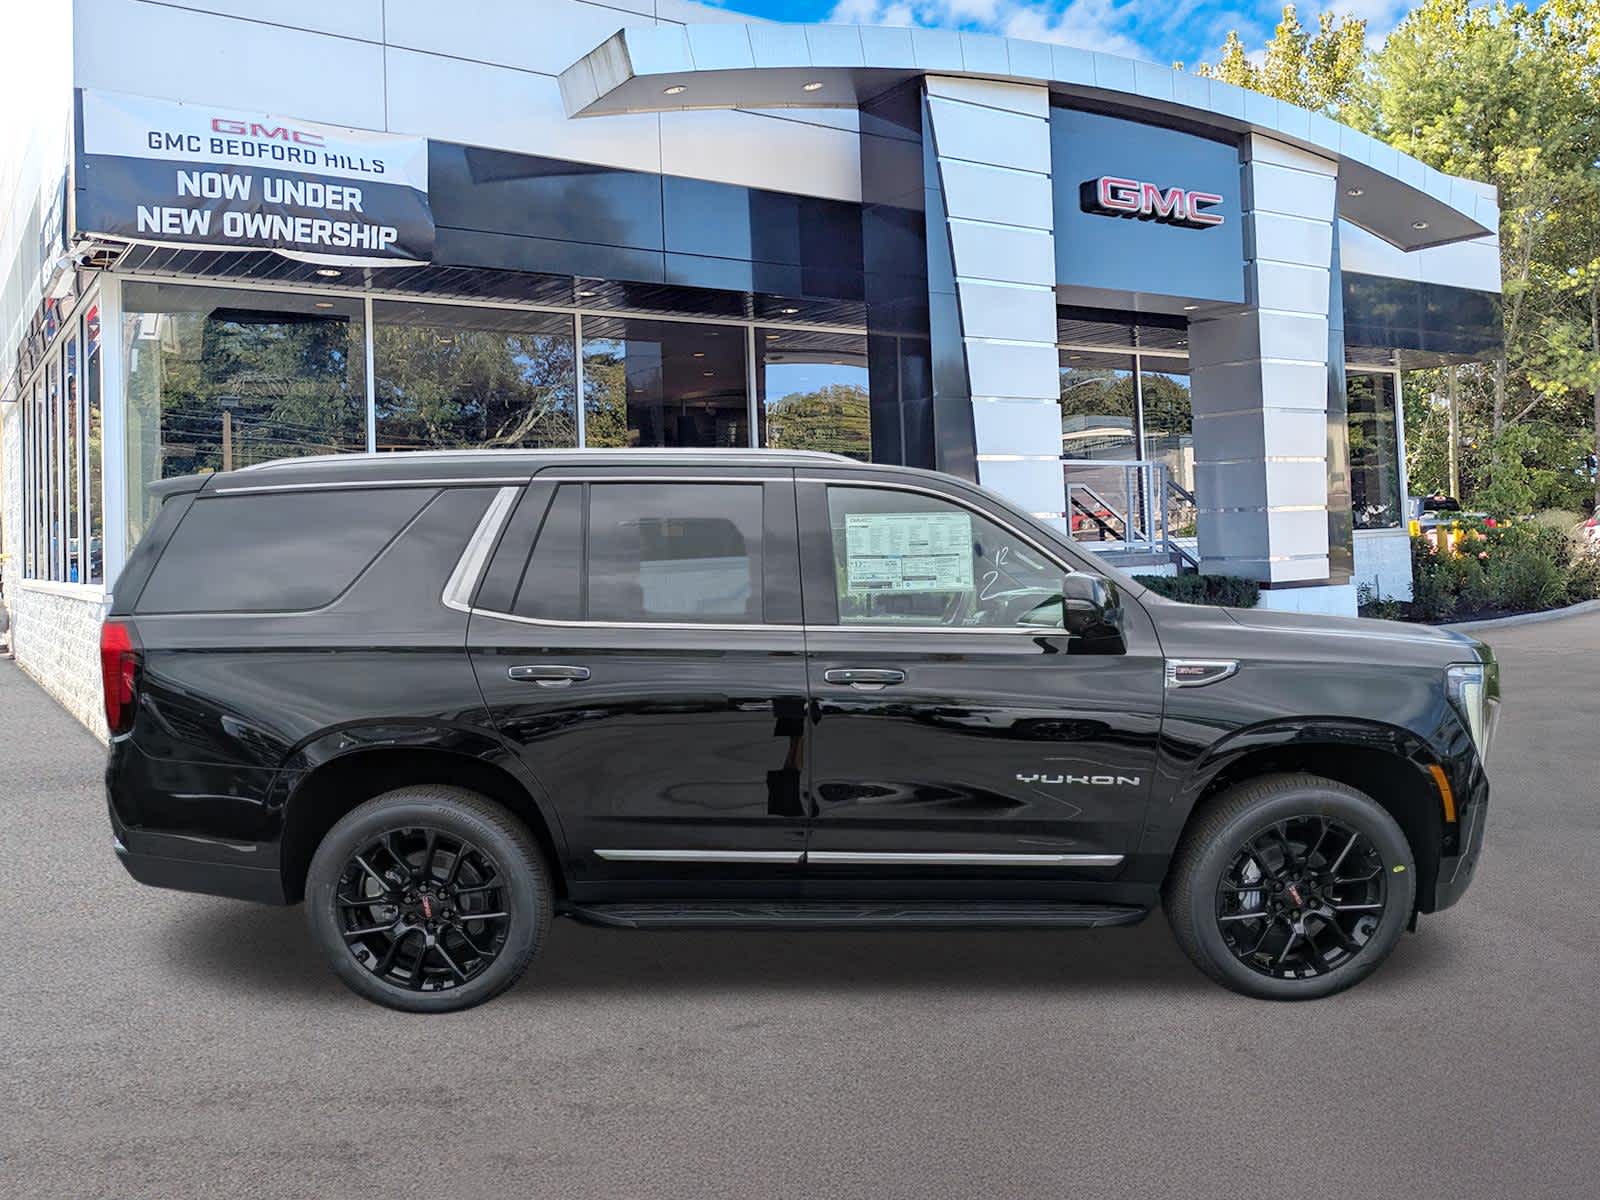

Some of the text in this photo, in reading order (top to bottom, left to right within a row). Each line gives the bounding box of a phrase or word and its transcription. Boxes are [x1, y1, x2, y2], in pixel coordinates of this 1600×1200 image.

[148, 131, 385, 174] GMC BEDFORD HILLS
[212, 118, 326, 147] GMC
[177, 170, 363, 213] NOW UNDER
[1097, 175, 1224, 225] GMC
[137, 205, 398, 250] NEW OWNERSHIP
[1016, 773, 1141, 787] YUKON
